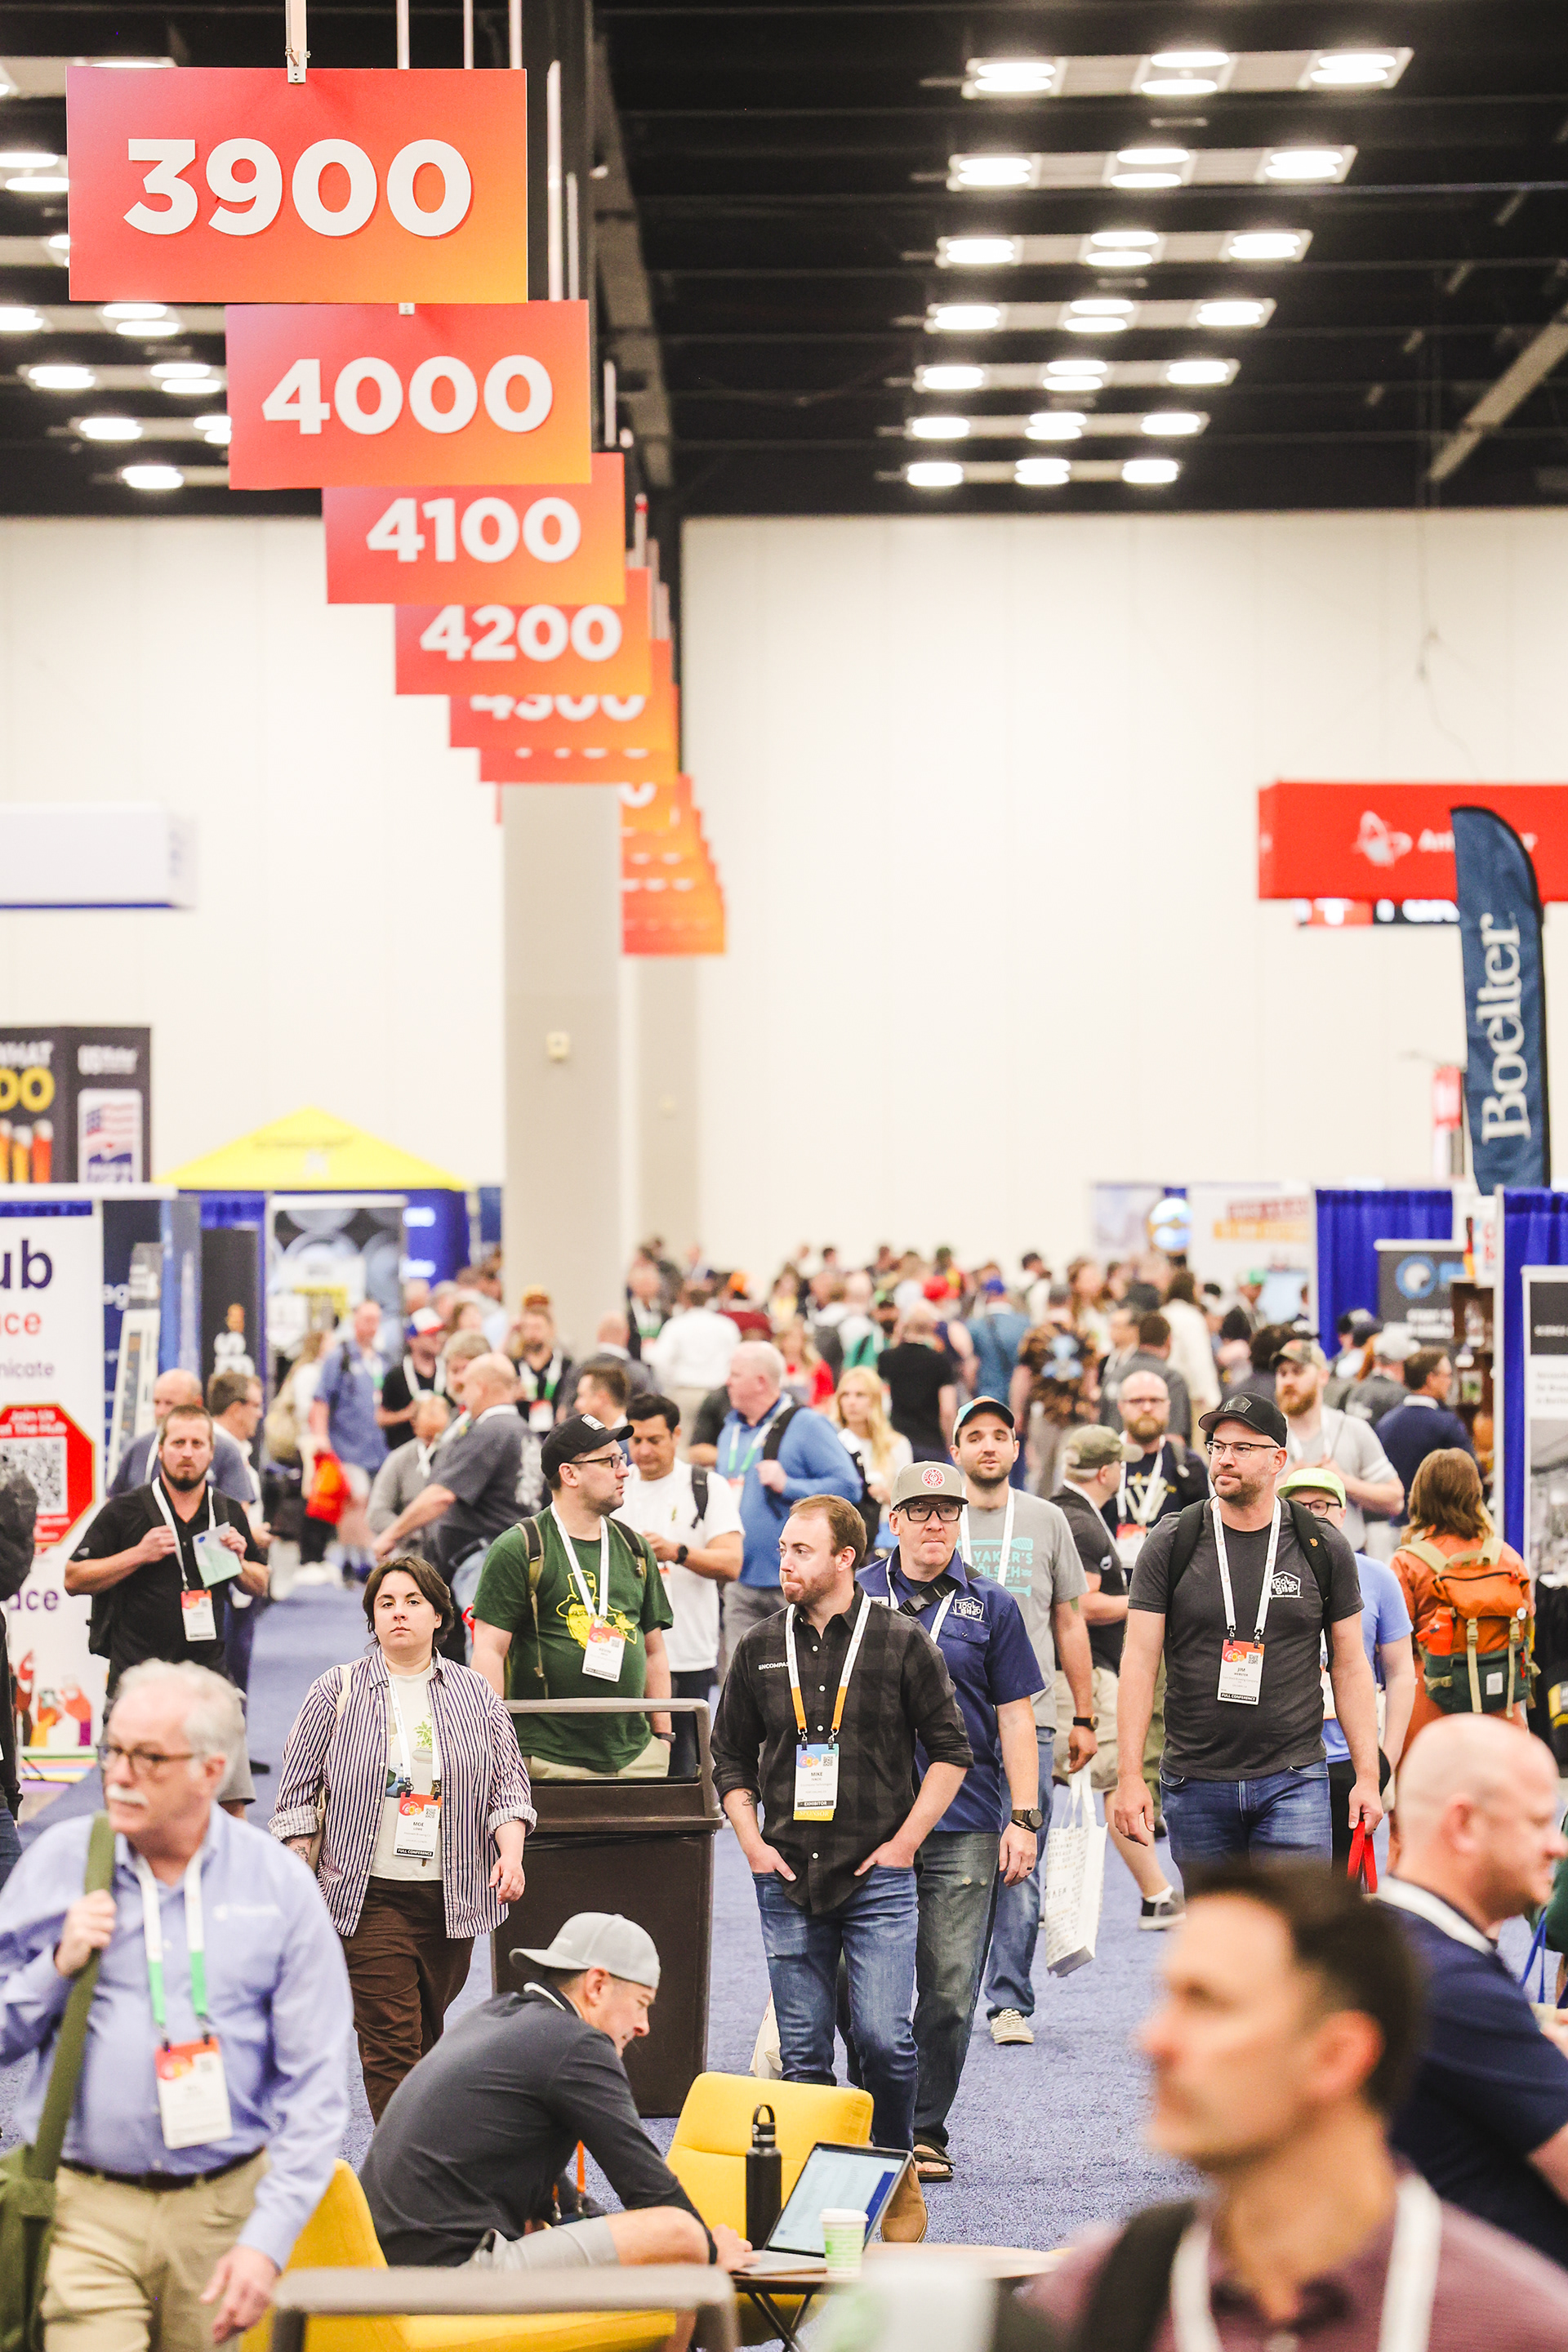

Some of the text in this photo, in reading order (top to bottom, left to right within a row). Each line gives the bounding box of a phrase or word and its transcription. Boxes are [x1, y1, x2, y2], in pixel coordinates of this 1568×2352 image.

[123, 138, 473, 237] 3900
[261, 355, 554, 435] 4000
[367, 497, 581, 564] 4100
[421, 604, 622, 662] 4200
[1476, 911, 1532, 1145] Boelter
[0, 1312, 42, 1335] ce
[758, 1661, 789, 1671] ENCOMPA
